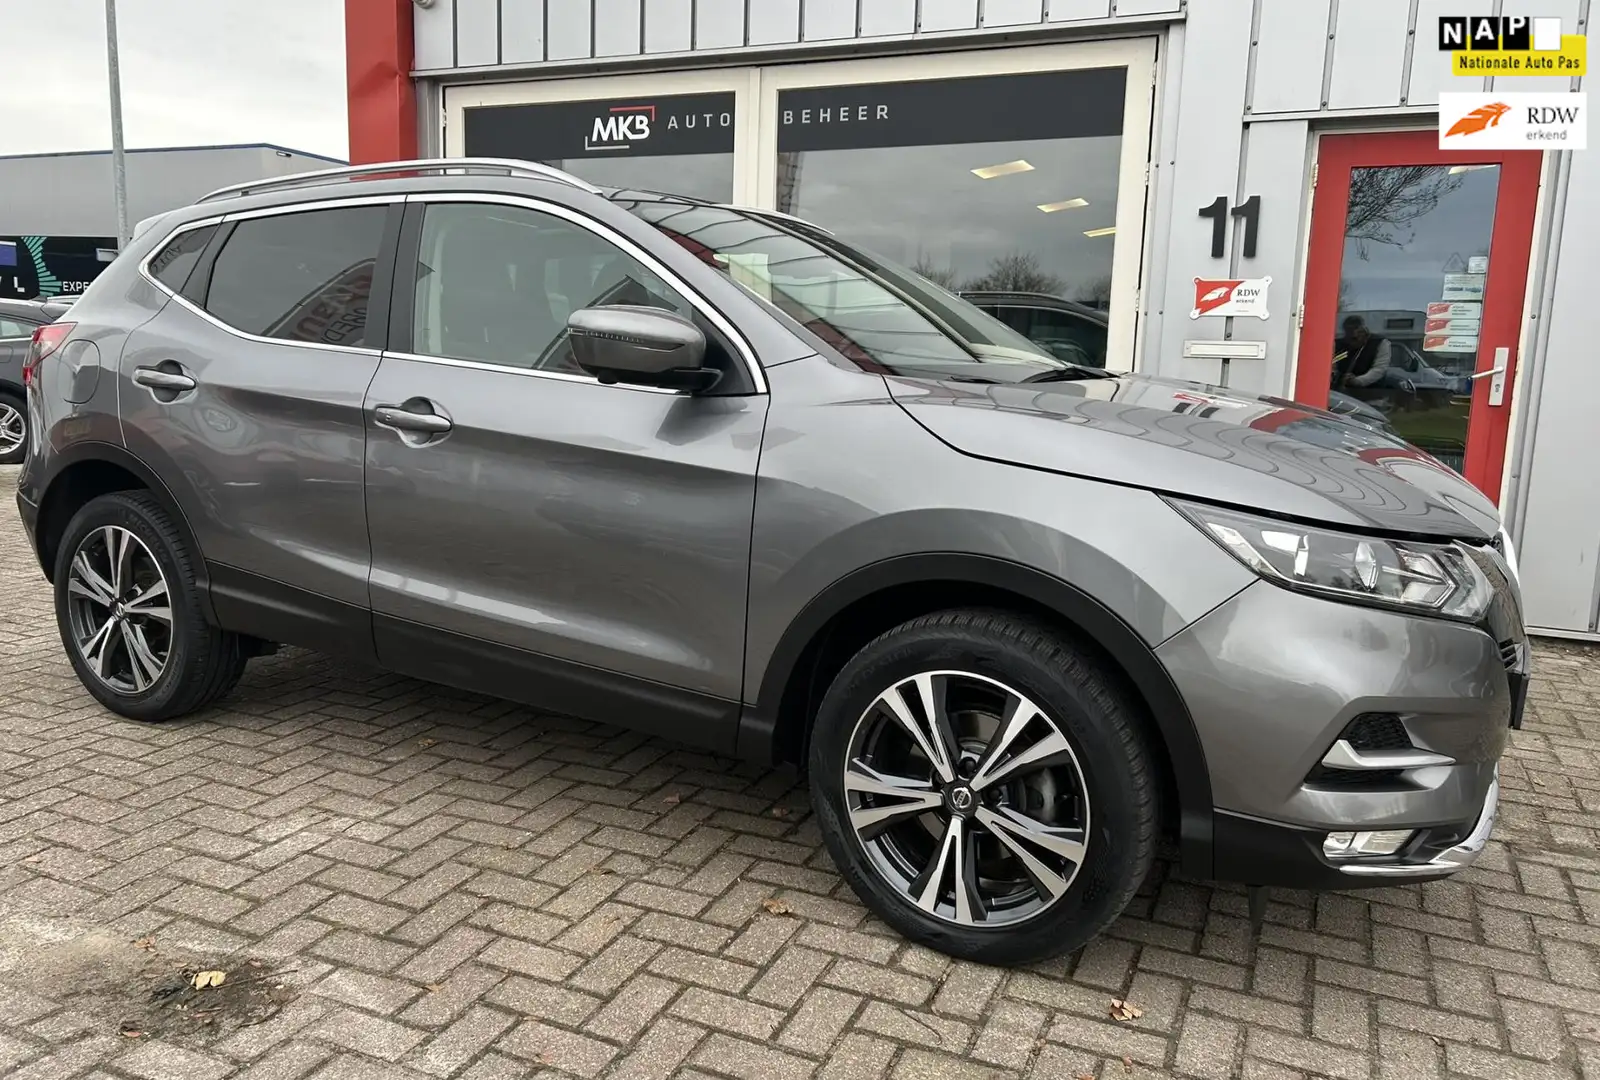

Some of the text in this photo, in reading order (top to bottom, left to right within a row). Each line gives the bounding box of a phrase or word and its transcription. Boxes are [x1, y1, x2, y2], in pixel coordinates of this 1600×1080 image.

[591, 105, 889, 141] MKB AUTO BEHEER
[1198, 195, 1261, 258] 11
[1236, 289, 1260, 297] RDW
